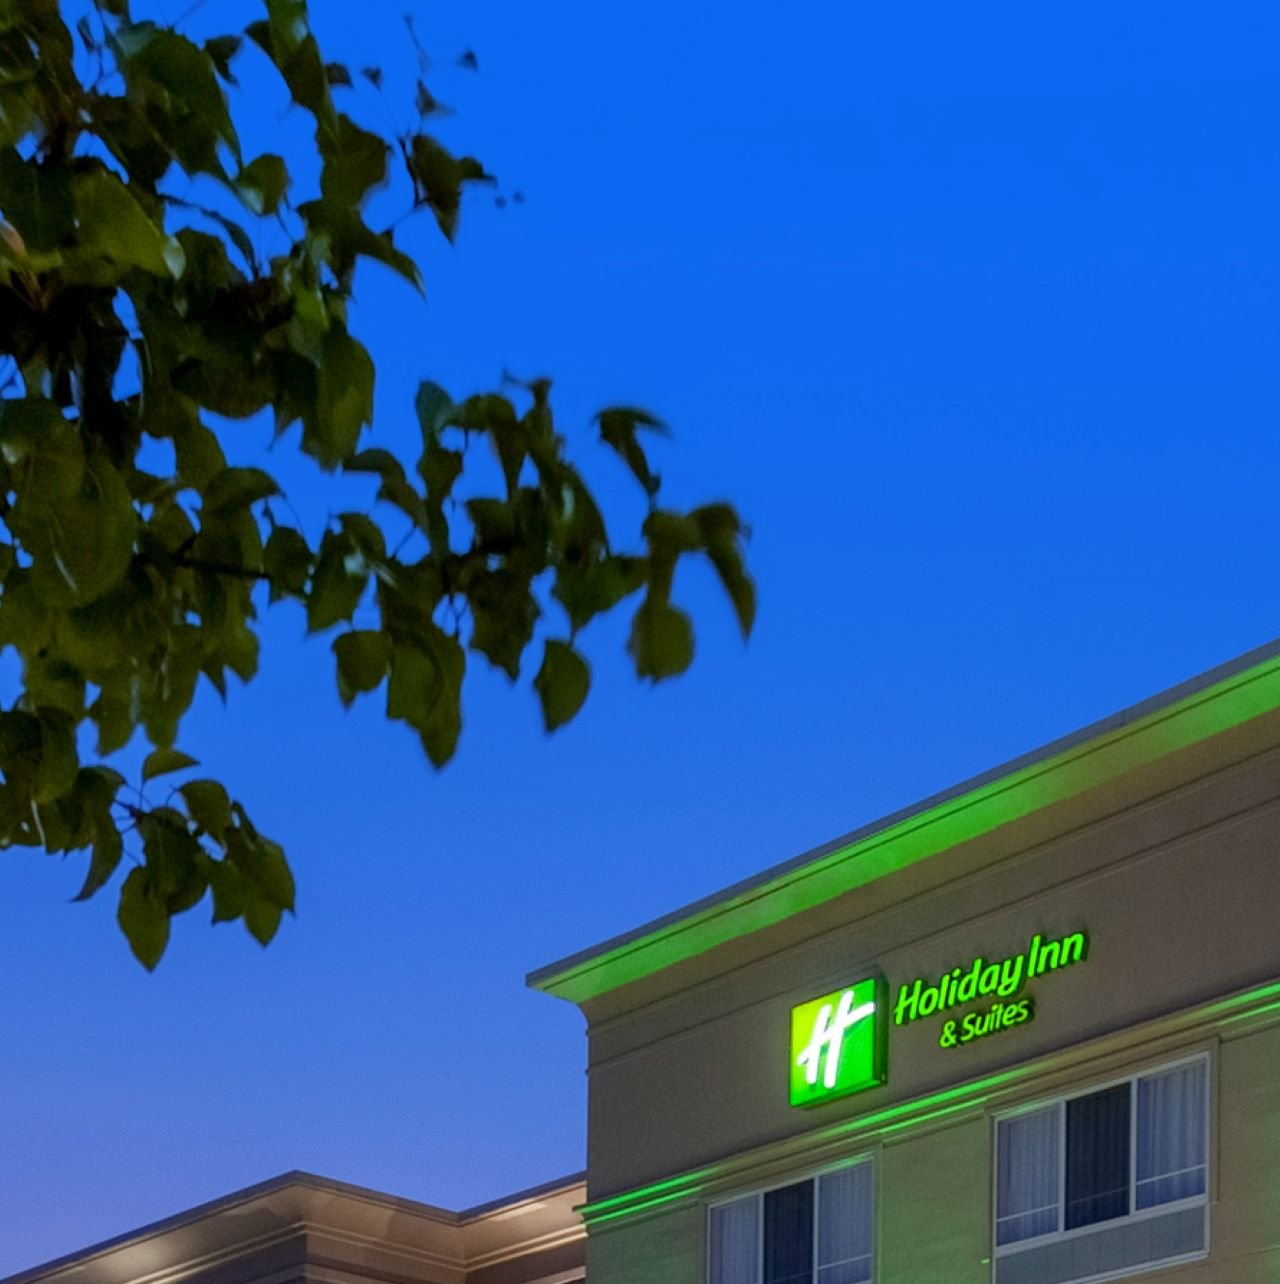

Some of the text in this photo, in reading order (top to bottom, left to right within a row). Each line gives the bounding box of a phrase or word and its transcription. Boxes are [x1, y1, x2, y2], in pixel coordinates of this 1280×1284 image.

[894, 932, 1084, 1025] Holiday Inn
[939, 1000, 1029, 1048] & Suites
